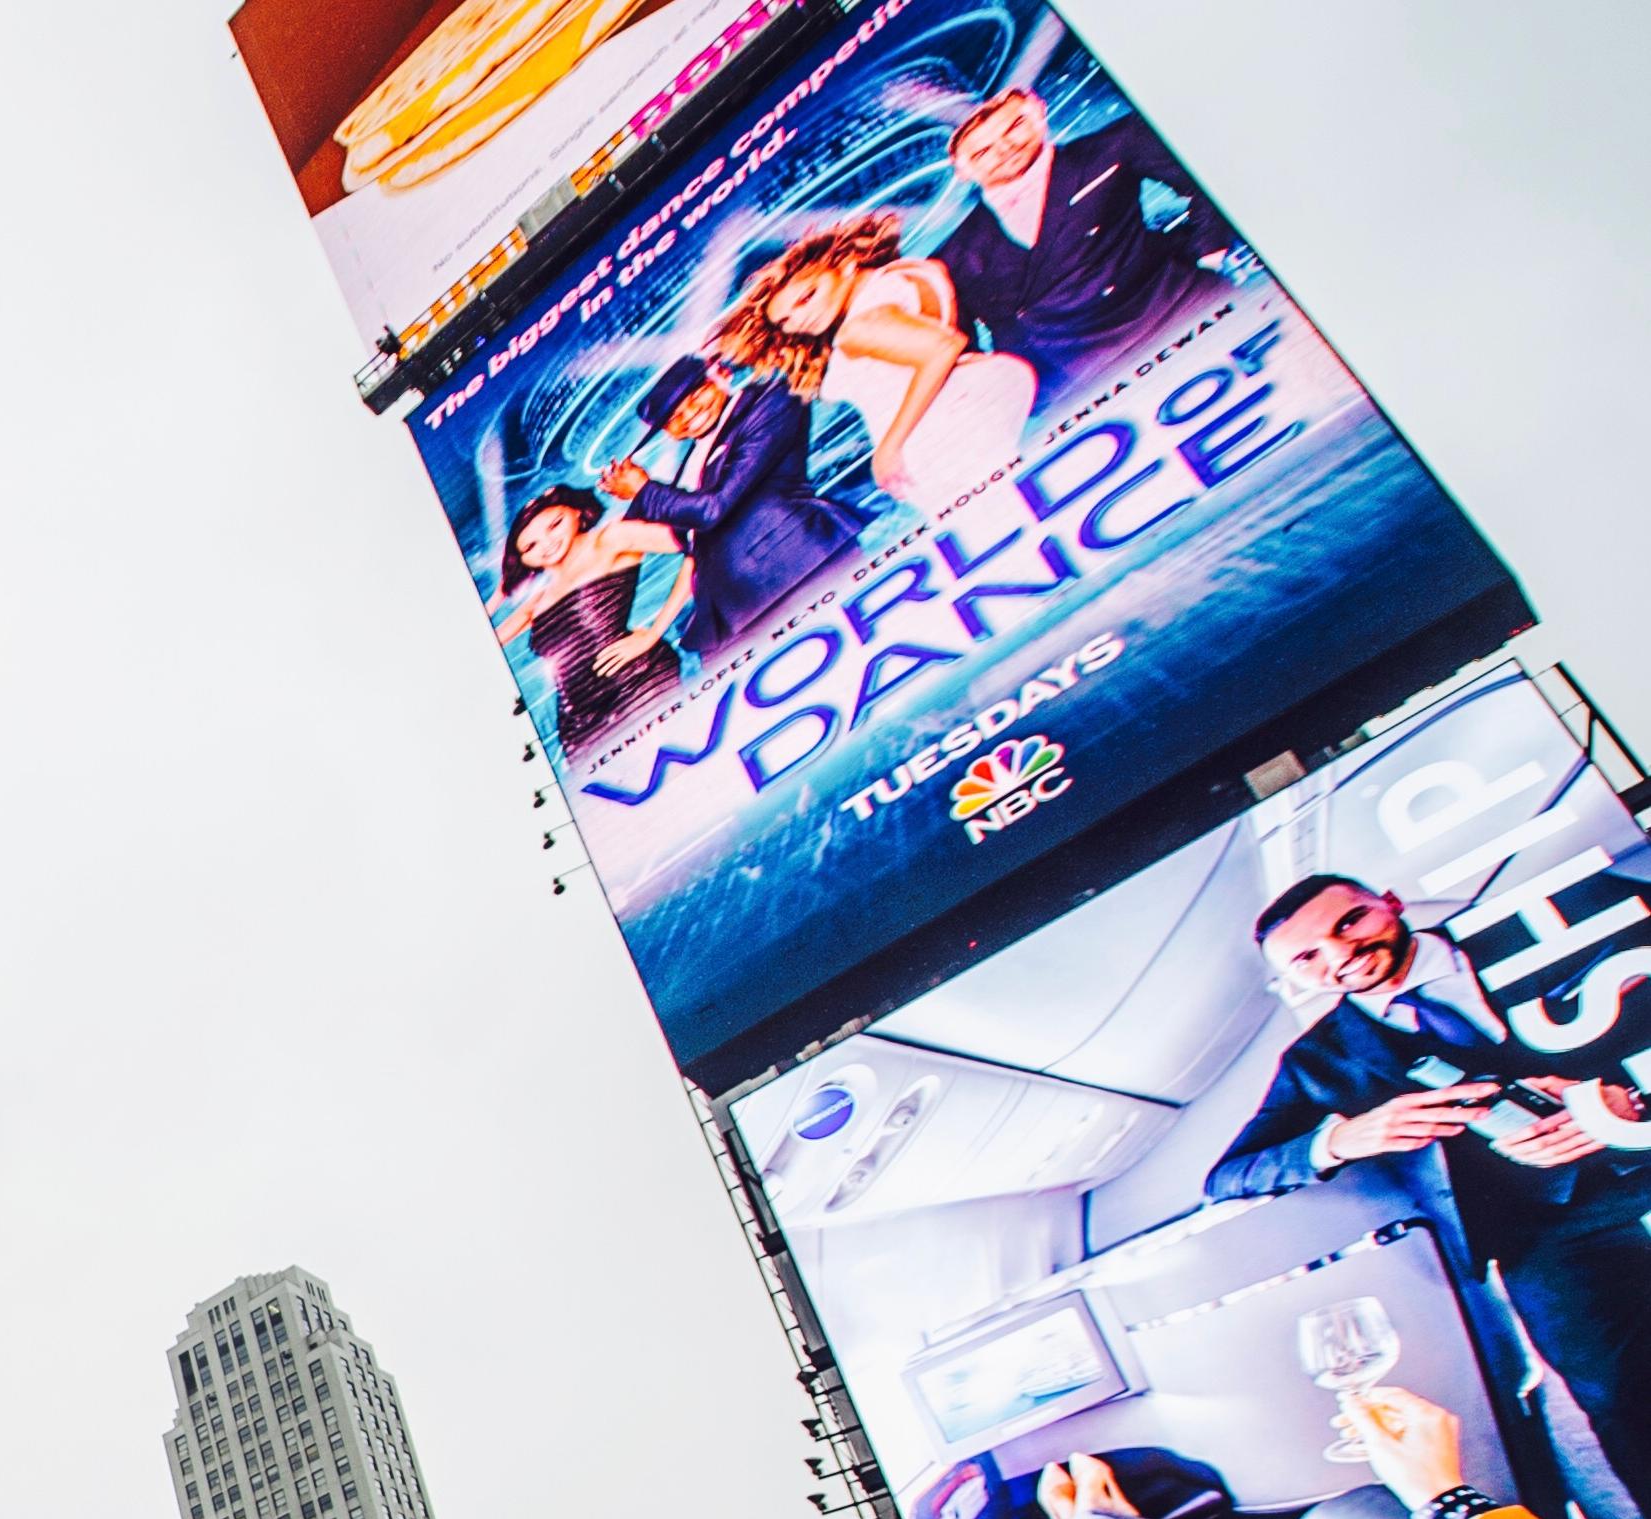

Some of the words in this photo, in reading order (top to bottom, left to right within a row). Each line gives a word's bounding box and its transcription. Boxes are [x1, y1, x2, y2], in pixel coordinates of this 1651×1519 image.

[425, 373, 485, 429] The
[488, 255, 612, 378] biggest
[616, 156, 726, 260] dance
[580, 285, 614, 323] in
[616, 229, 677, 287] the
[681, 126, 798, 230] world.
[581, 420, 1137, 806] WORLD
[1156, 318, 1282, 426] OF
[587, 701, 685, 775] JENNIFER
[688, 648, 757, 702] LOPEZ
[771, 591, 837, 642] NE-YO
[852, 524, 931, 583] DEREK
[937, 455, 1025, 521] HOUGH
[1044, 381, 1131, 446] JENNA
[1135, 303, 1236, 378] DEWAN
[738, 383, 1305, 793] DANCE
[839, 633, 1127, 821] TUESDAYS
[962, 768, 1074, 844] NBC
